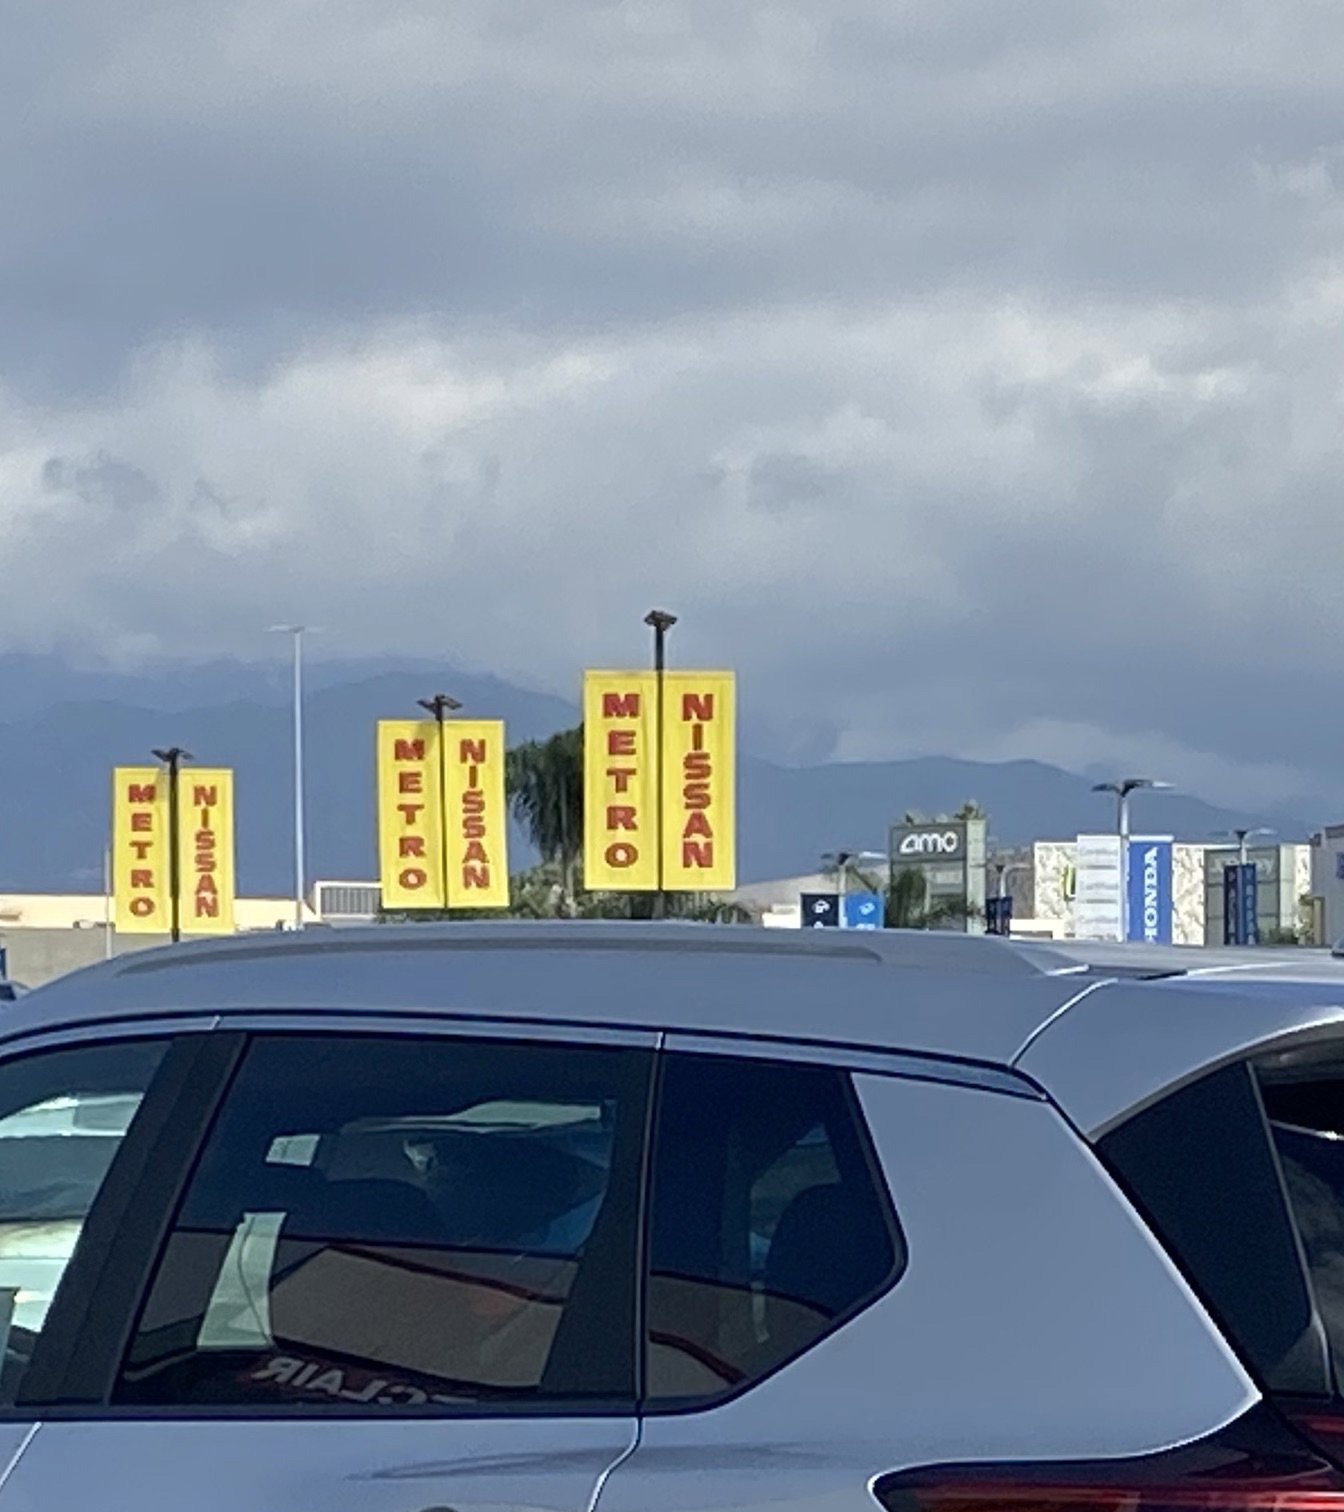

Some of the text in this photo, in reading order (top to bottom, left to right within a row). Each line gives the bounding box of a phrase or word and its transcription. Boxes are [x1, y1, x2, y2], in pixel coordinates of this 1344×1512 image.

[128, 783, 156, 918] METRO
[193, 784, 218, 918] NISSAN
[394, 738, 427, 890] METRO
[459, 738, 490, 890] NISSAN
[602, 693, 640, 868] METRO
[681, 693, 714, 868] NISSAN
